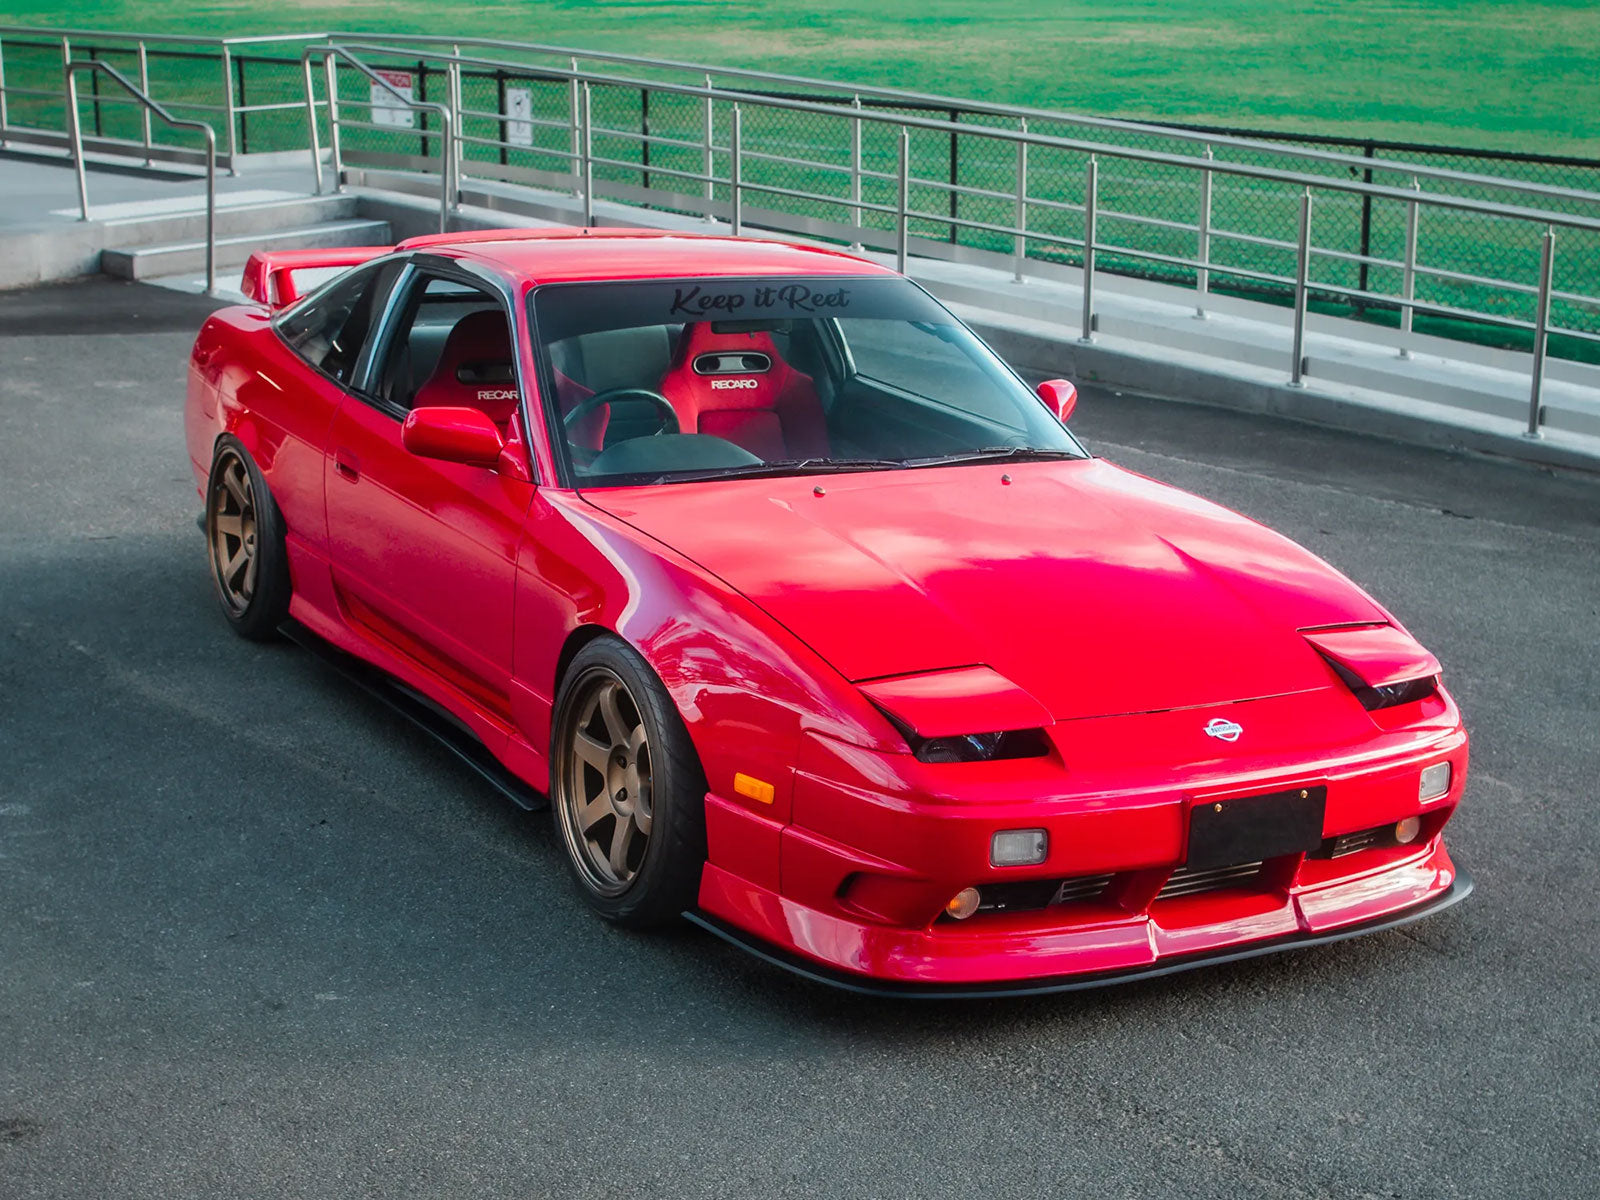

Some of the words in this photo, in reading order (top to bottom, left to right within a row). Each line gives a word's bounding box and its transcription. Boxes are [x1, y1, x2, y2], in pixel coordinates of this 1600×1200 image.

[670, 286, 745, 315] Keep
[754, 287, 777, 308] it
[778, 284, 851, 312] Reet
[711, 379, 758, 389] RECARO
[477, 390, 519, 400] RECAR
